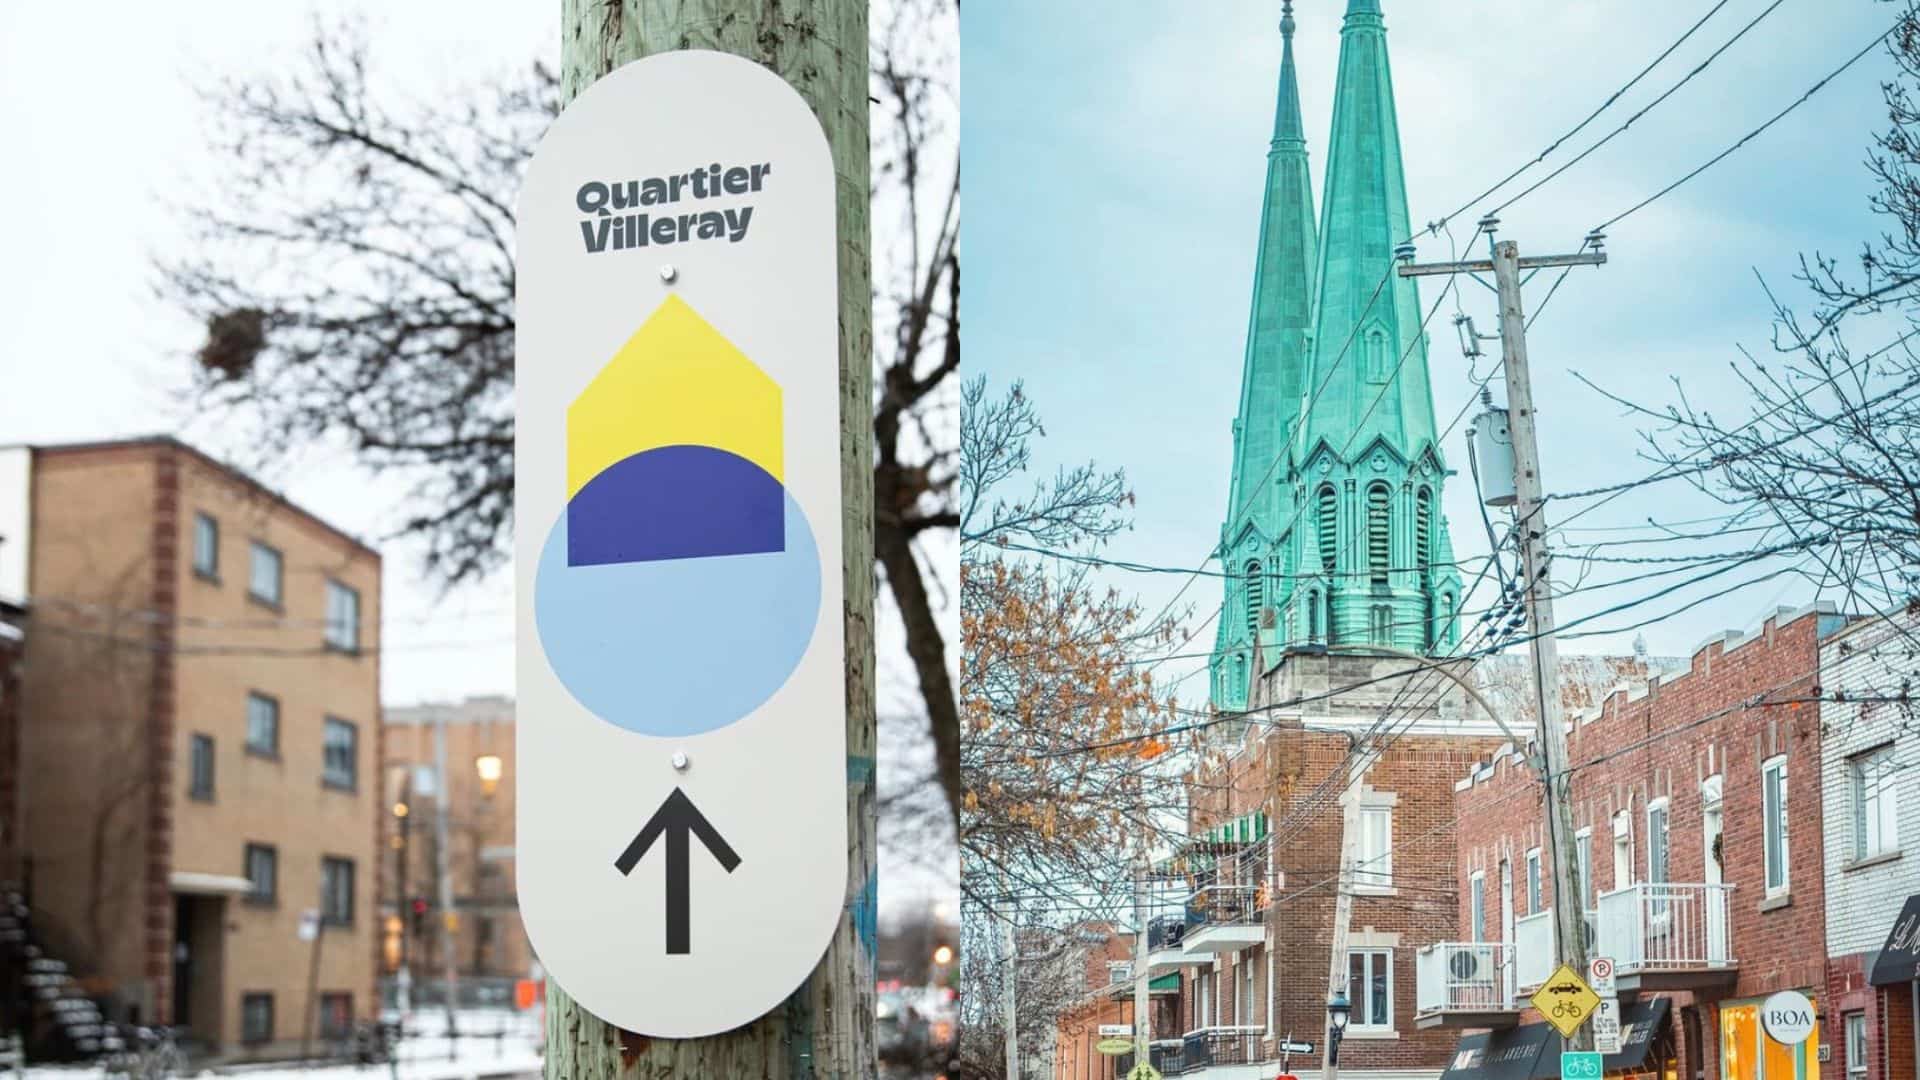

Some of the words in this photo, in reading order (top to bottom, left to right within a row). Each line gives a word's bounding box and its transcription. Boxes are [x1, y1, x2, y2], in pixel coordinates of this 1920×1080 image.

[576, 162, 771, 217] Quartier
[580, 206, 754, 254] Villeray
[1601, 1002, 1609, 1015] P
[1770, 1009, 1811, 1026] BOA
